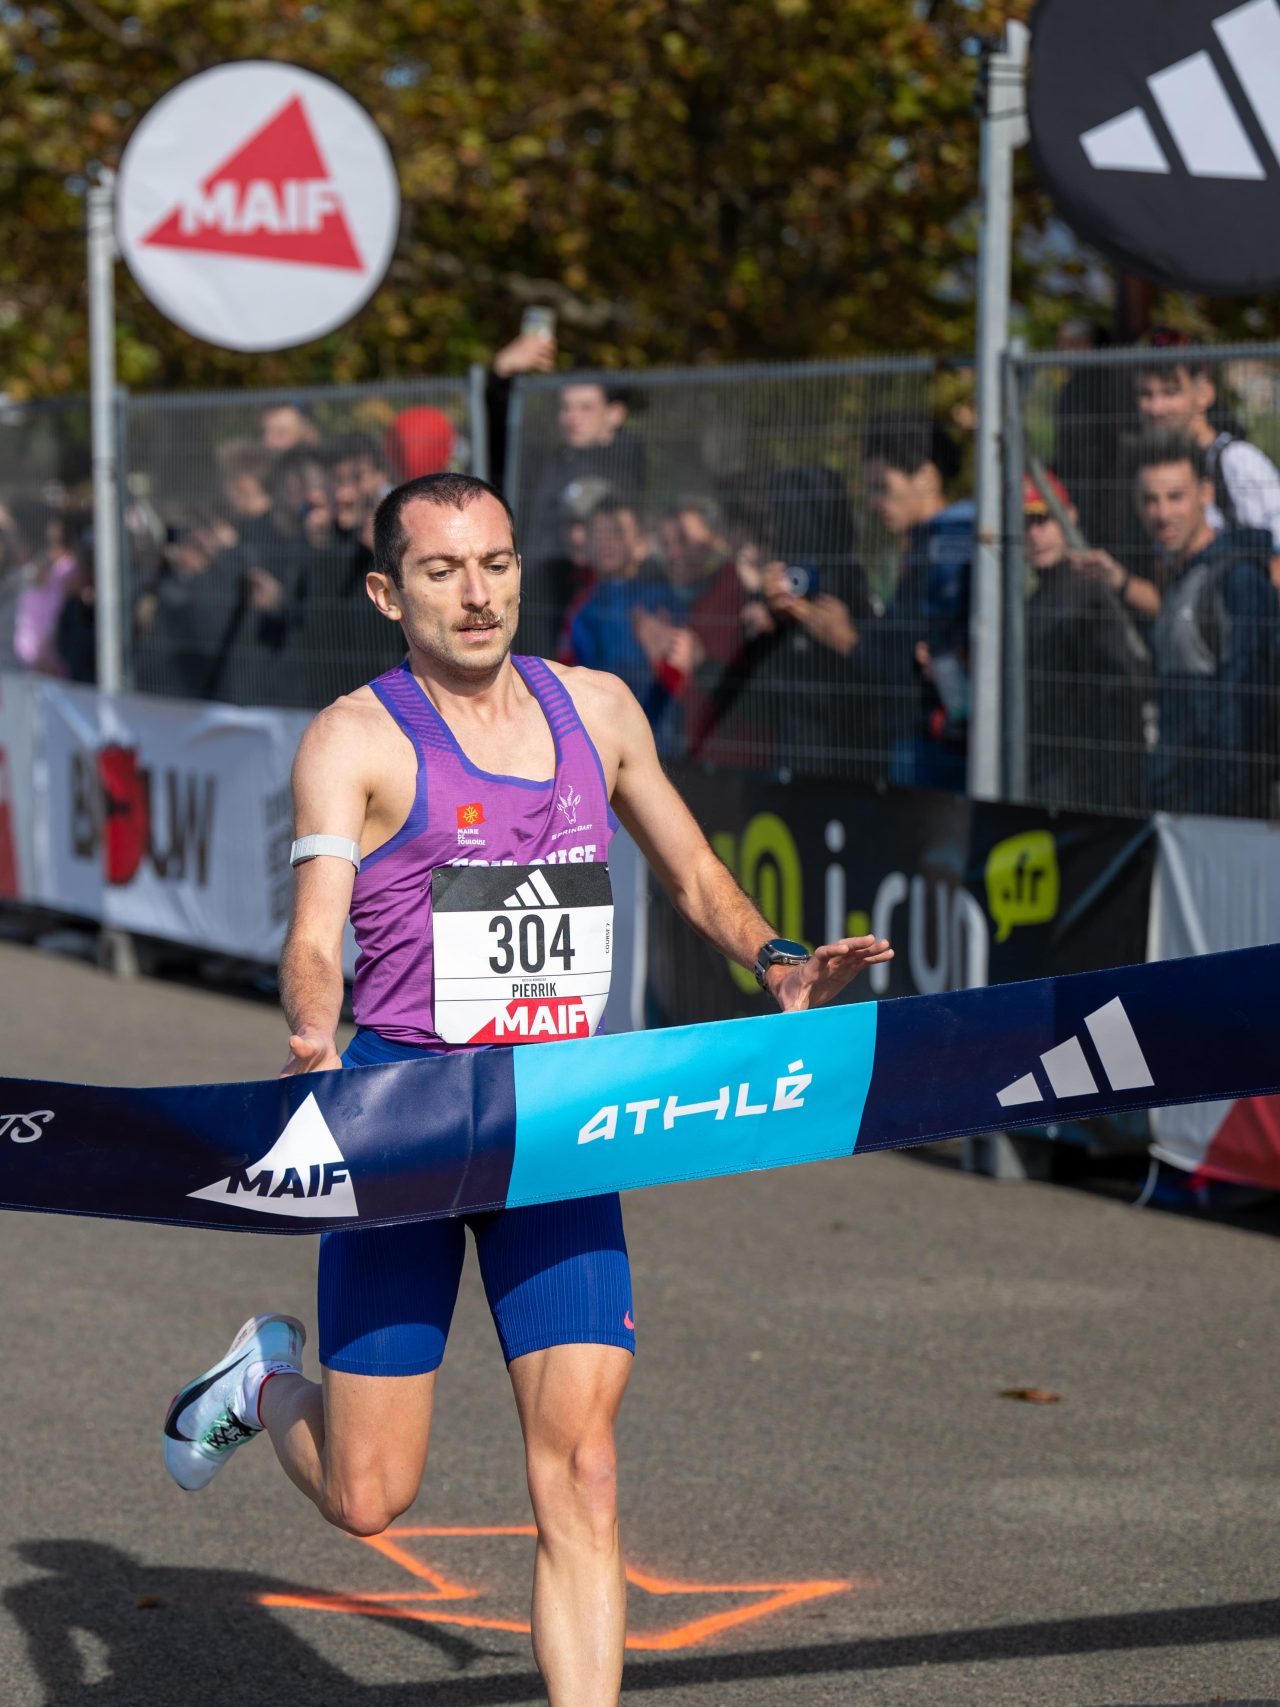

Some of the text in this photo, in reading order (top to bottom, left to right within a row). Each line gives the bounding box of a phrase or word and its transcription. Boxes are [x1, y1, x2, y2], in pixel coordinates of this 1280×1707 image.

[178, 178, 338, 236] MAIF
[488, 913, 576, 975] 304
[511, 982, 558, 998] PIERRIK
[494, 1003, 586, 1036] MAIF
[577, 1058, 813, 1145] ATHLÉ
[225, 1161, 349, 1199] MAIF
